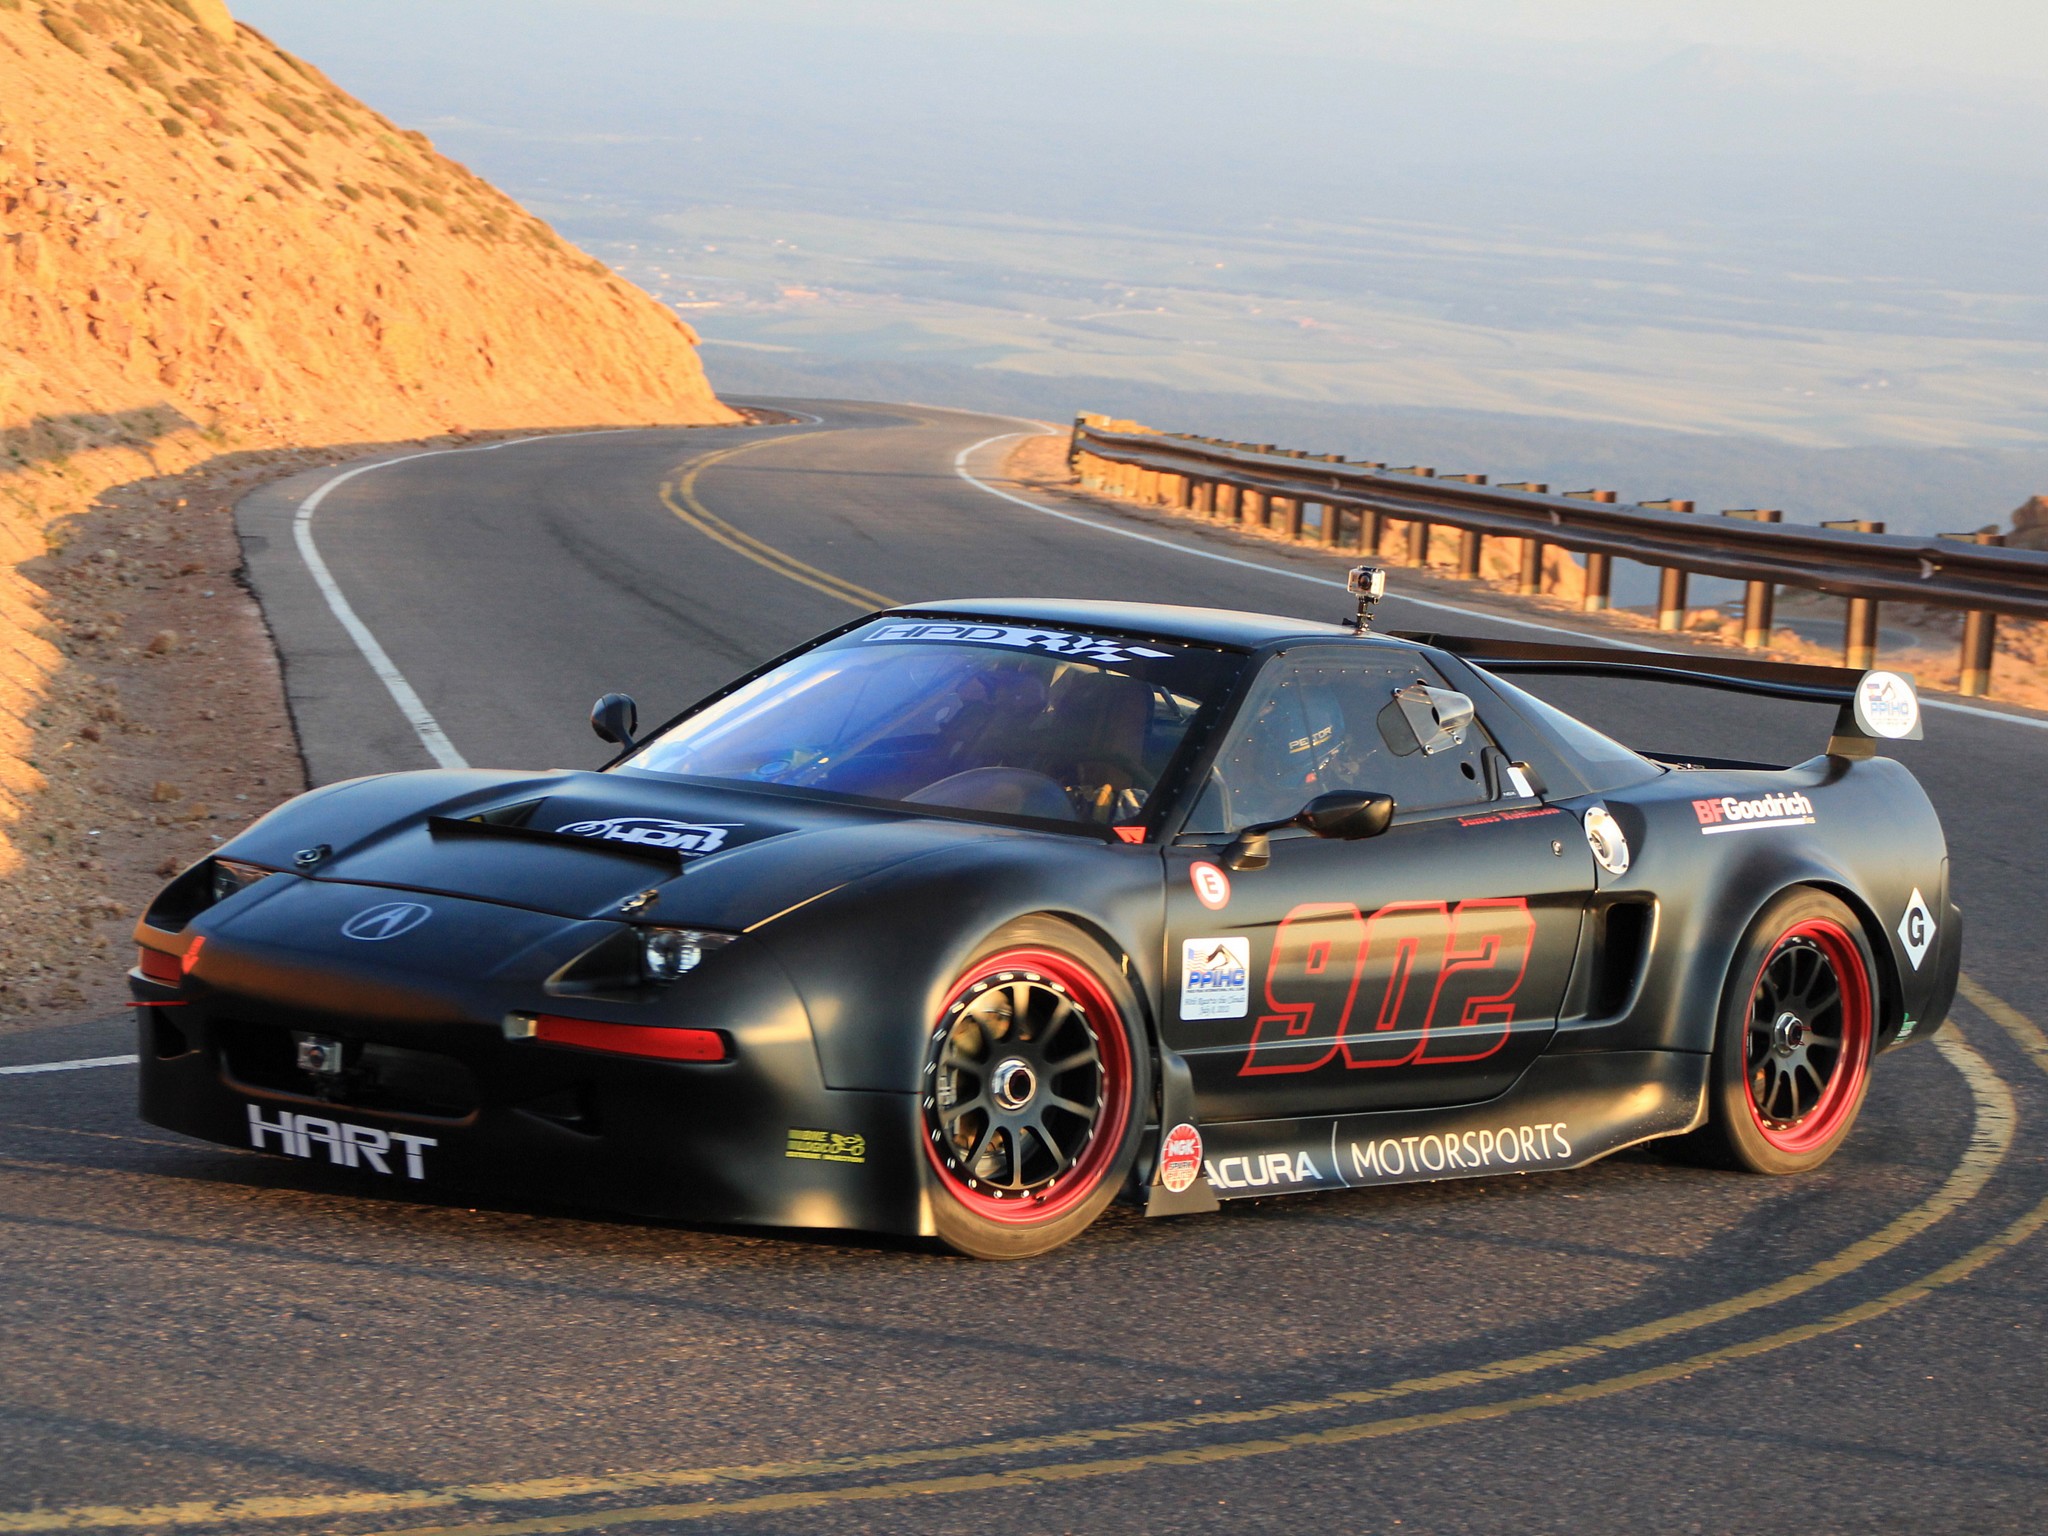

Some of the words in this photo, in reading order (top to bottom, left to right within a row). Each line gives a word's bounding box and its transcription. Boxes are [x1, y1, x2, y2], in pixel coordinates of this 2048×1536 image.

[872, 626, 1007, 640] HPD
[1288, 726, 1333, 750] PETOR
[1692, 792, 1813, 824] BFGoodrich
[1203, 873, 1219, 894] E
[1907, 907, 1924, 947] G
[1237, 897, 1536, 1077] 902
[247, 1103, 437, 1180] HART
[1351, 1122, 1572, 1178] MOTORSPORTS
